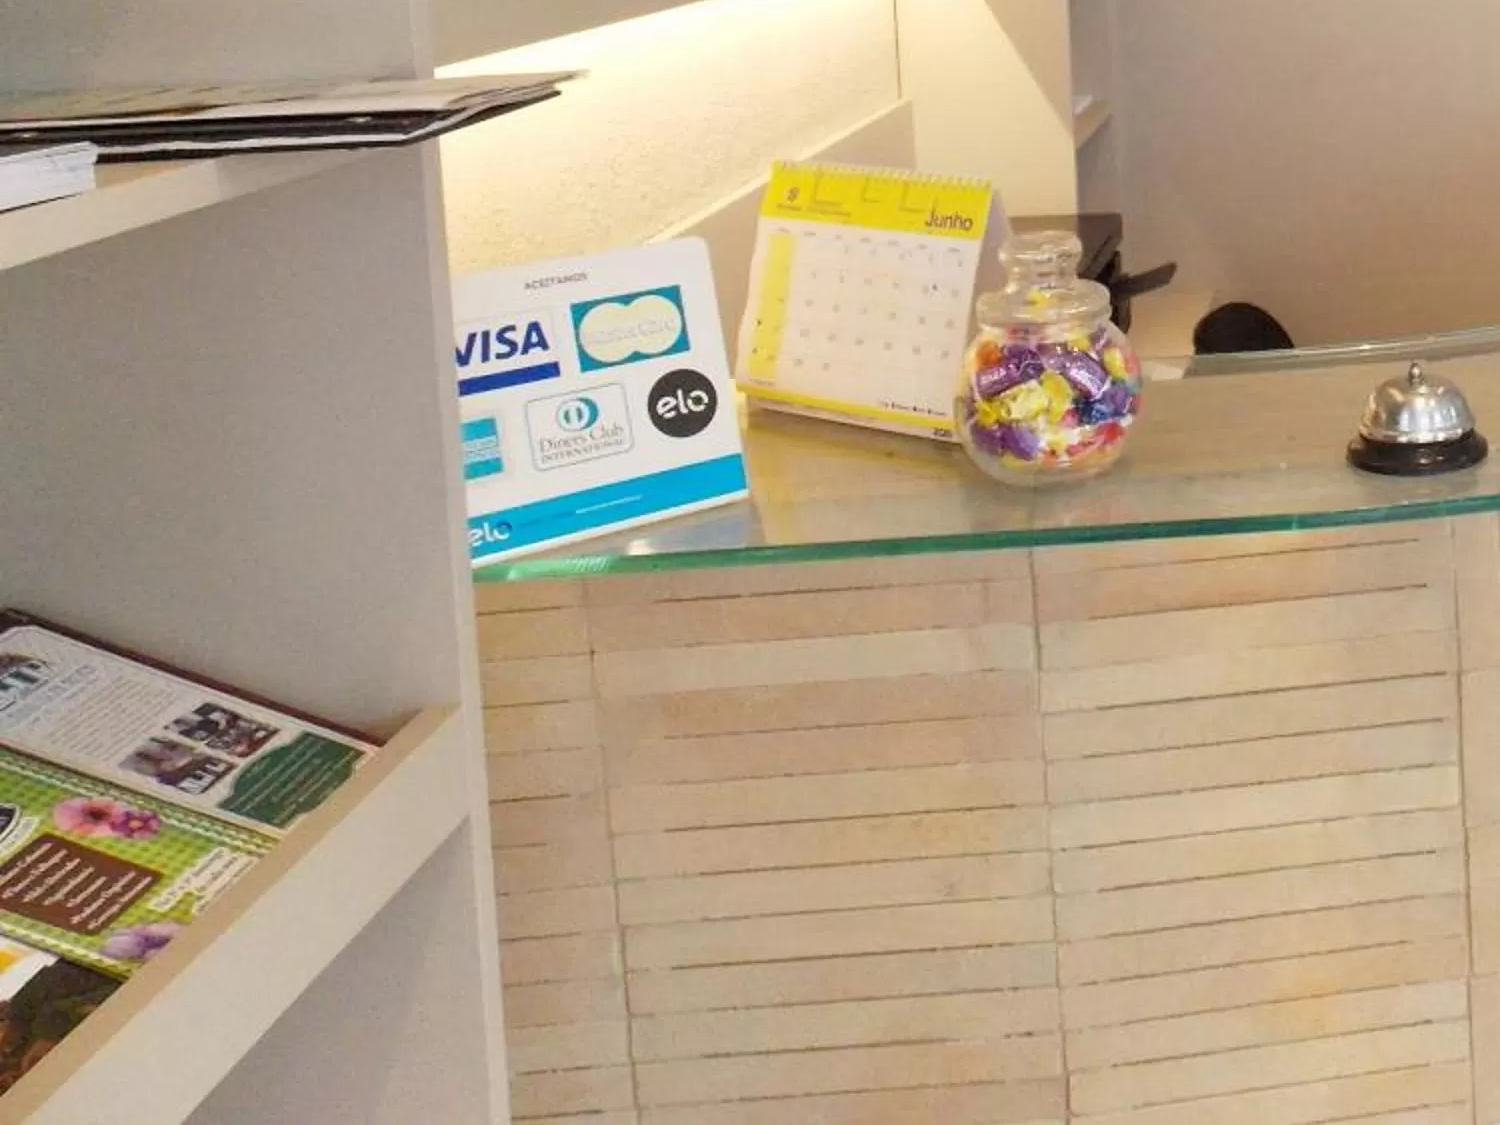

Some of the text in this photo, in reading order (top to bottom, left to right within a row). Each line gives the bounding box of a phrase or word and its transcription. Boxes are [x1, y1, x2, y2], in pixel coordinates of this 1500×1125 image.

[924, 208, 973, 232] Junho
[455, 320, 550, 368] VISA
[656, 388, 709, 419] elo
[540, 421, 624, 453] Diners Club
[467, 520, 513, 547] elo
